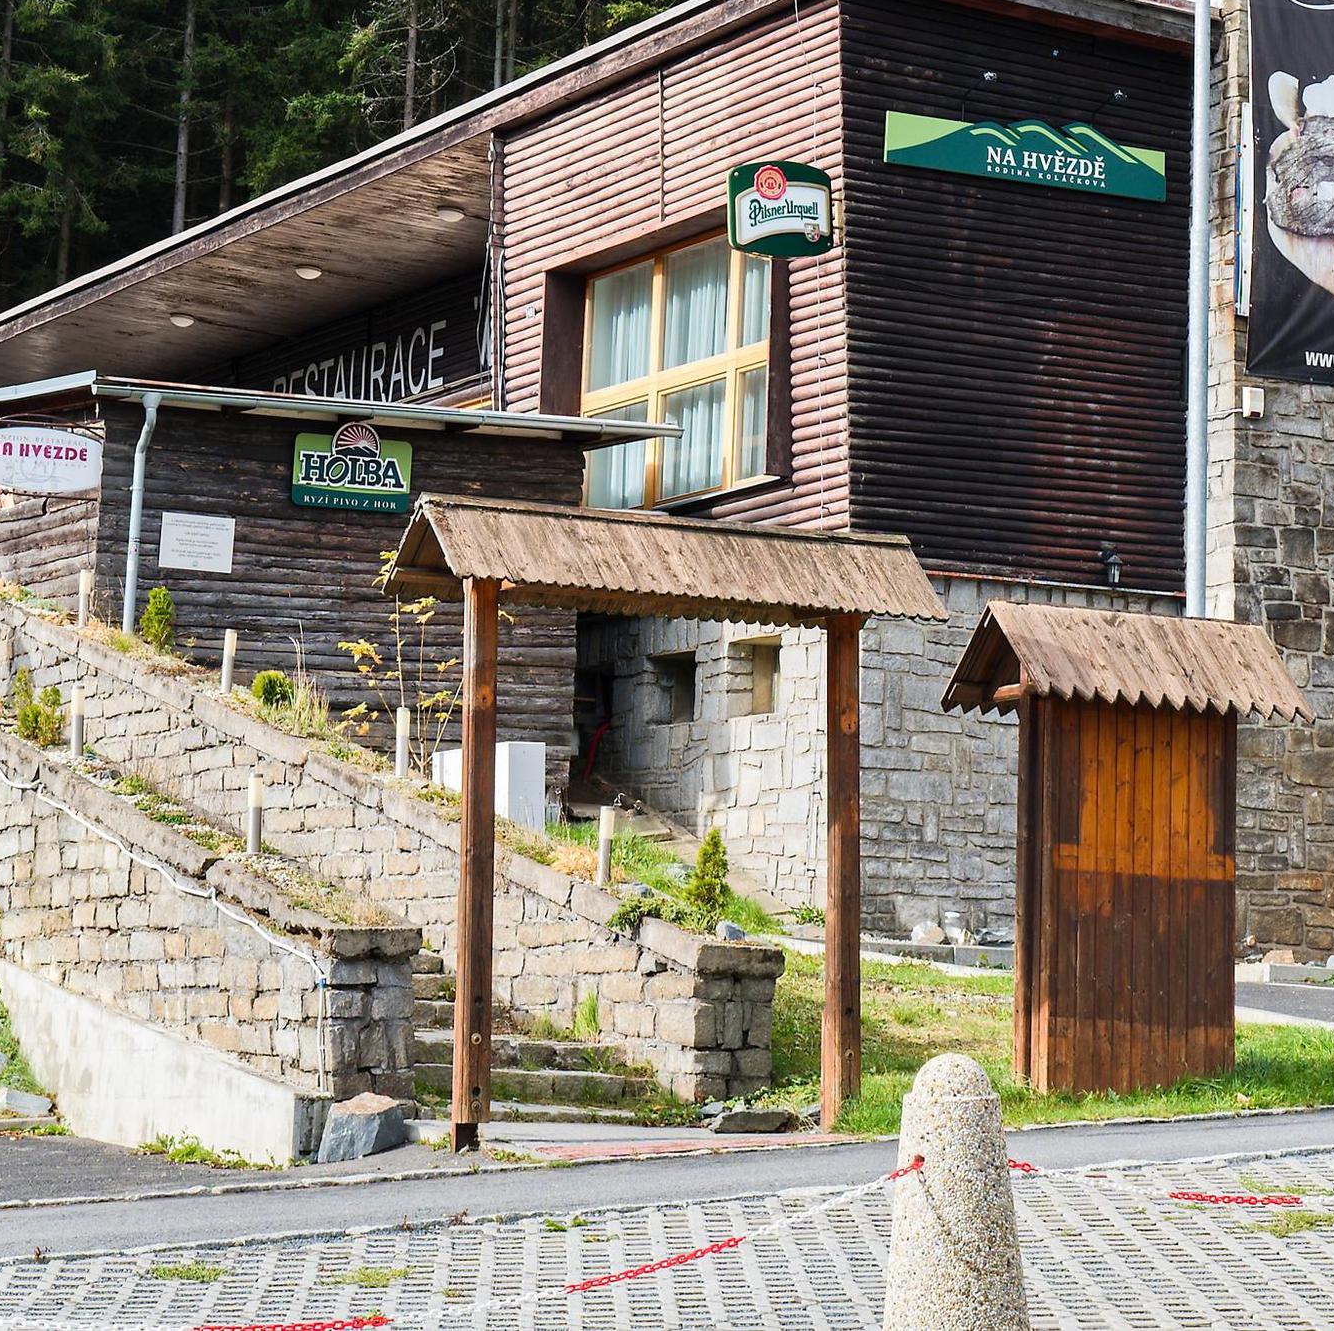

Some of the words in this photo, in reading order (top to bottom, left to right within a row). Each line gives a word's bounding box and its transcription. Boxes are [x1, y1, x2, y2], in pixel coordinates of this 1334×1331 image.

[986, 145, 1017, 167] NA
[1022, 149, 1106, 179] HVĚZDĚ
[986, 165, 1030, 178] RODINA
[1038, 172, 1106, 188] KOLÁČKOVA
[748, 198, 785, 227] Pilsner
[785, 199, 819, 221] Urquell
[300, 451, 406, 490] HOLBA
[303, 494, 329, 505] RYZÍ
[333, 497, 359, 507] PIVO
[374, 500, 396, 510] HOR
